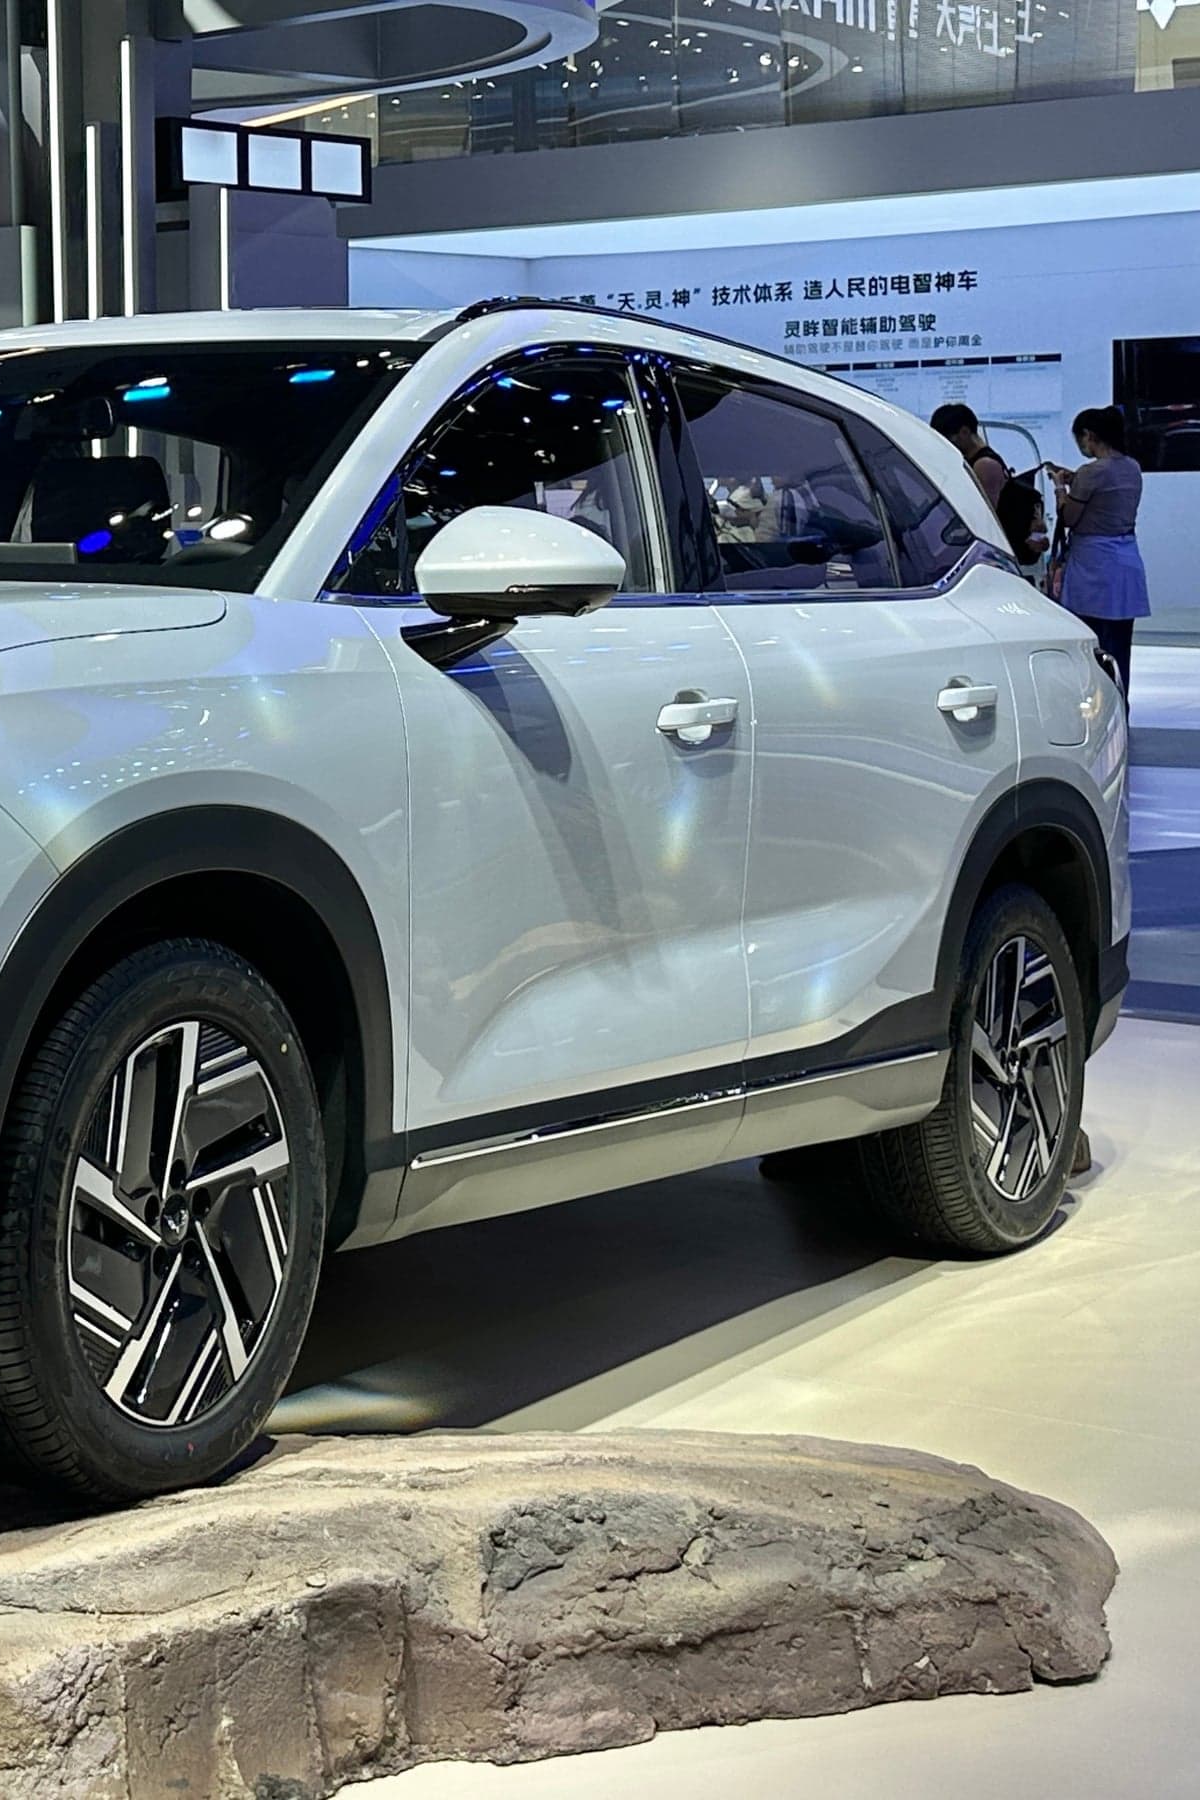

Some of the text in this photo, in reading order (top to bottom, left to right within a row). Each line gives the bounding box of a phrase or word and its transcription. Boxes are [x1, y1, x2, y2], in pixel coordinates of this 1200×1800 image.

[711, 281, 793, 306] 技术体系
[803, 270, 979, 301] 造人民的电智神车
